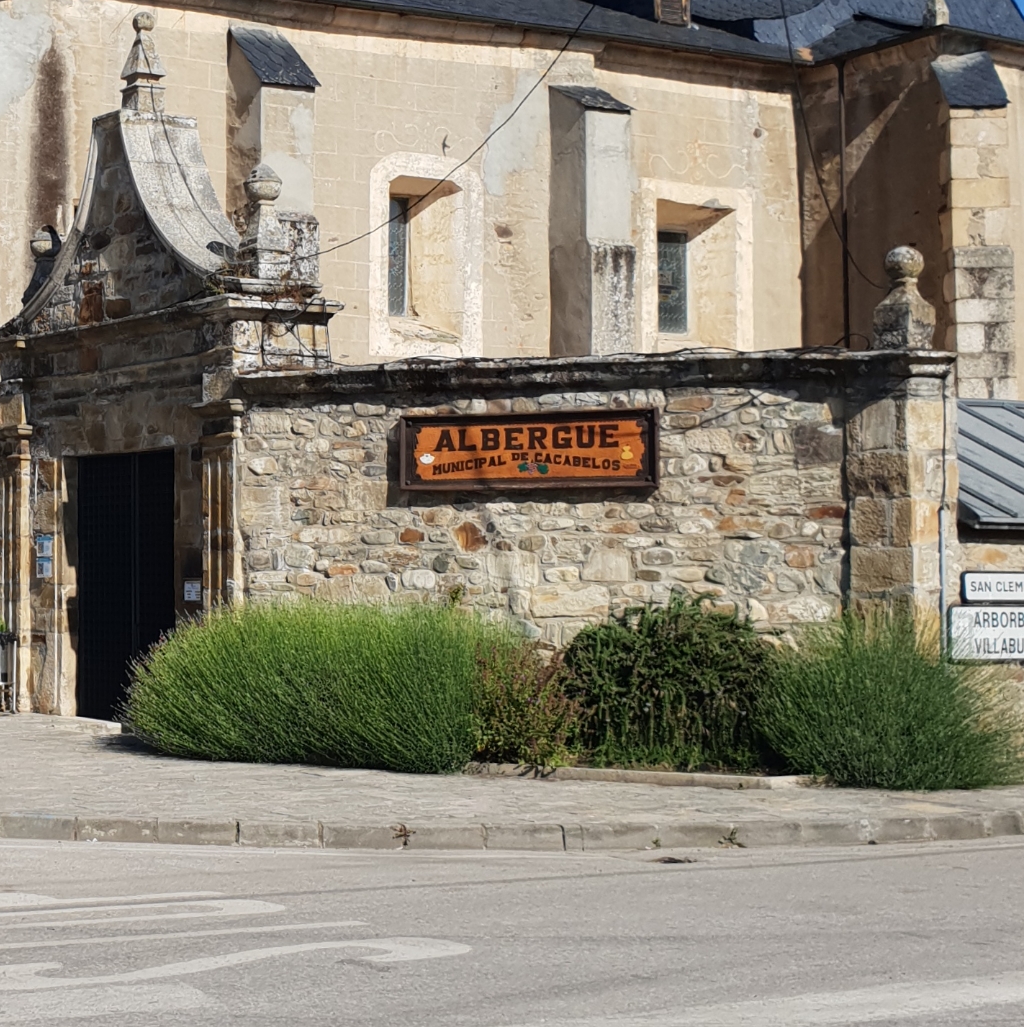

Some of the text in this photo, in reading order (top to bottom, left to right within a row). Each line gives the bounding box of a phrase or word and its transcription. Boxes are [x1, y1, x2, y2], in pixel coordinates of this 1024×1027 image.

[434, 425, 619, 452] ALBERGUE
[433, 452, 621, 475] MUNICIPAL DE CACABELOS
[970, 581, 1024, 592] SAN CLEM
[973, 612, 1024, 628] ARBORB
